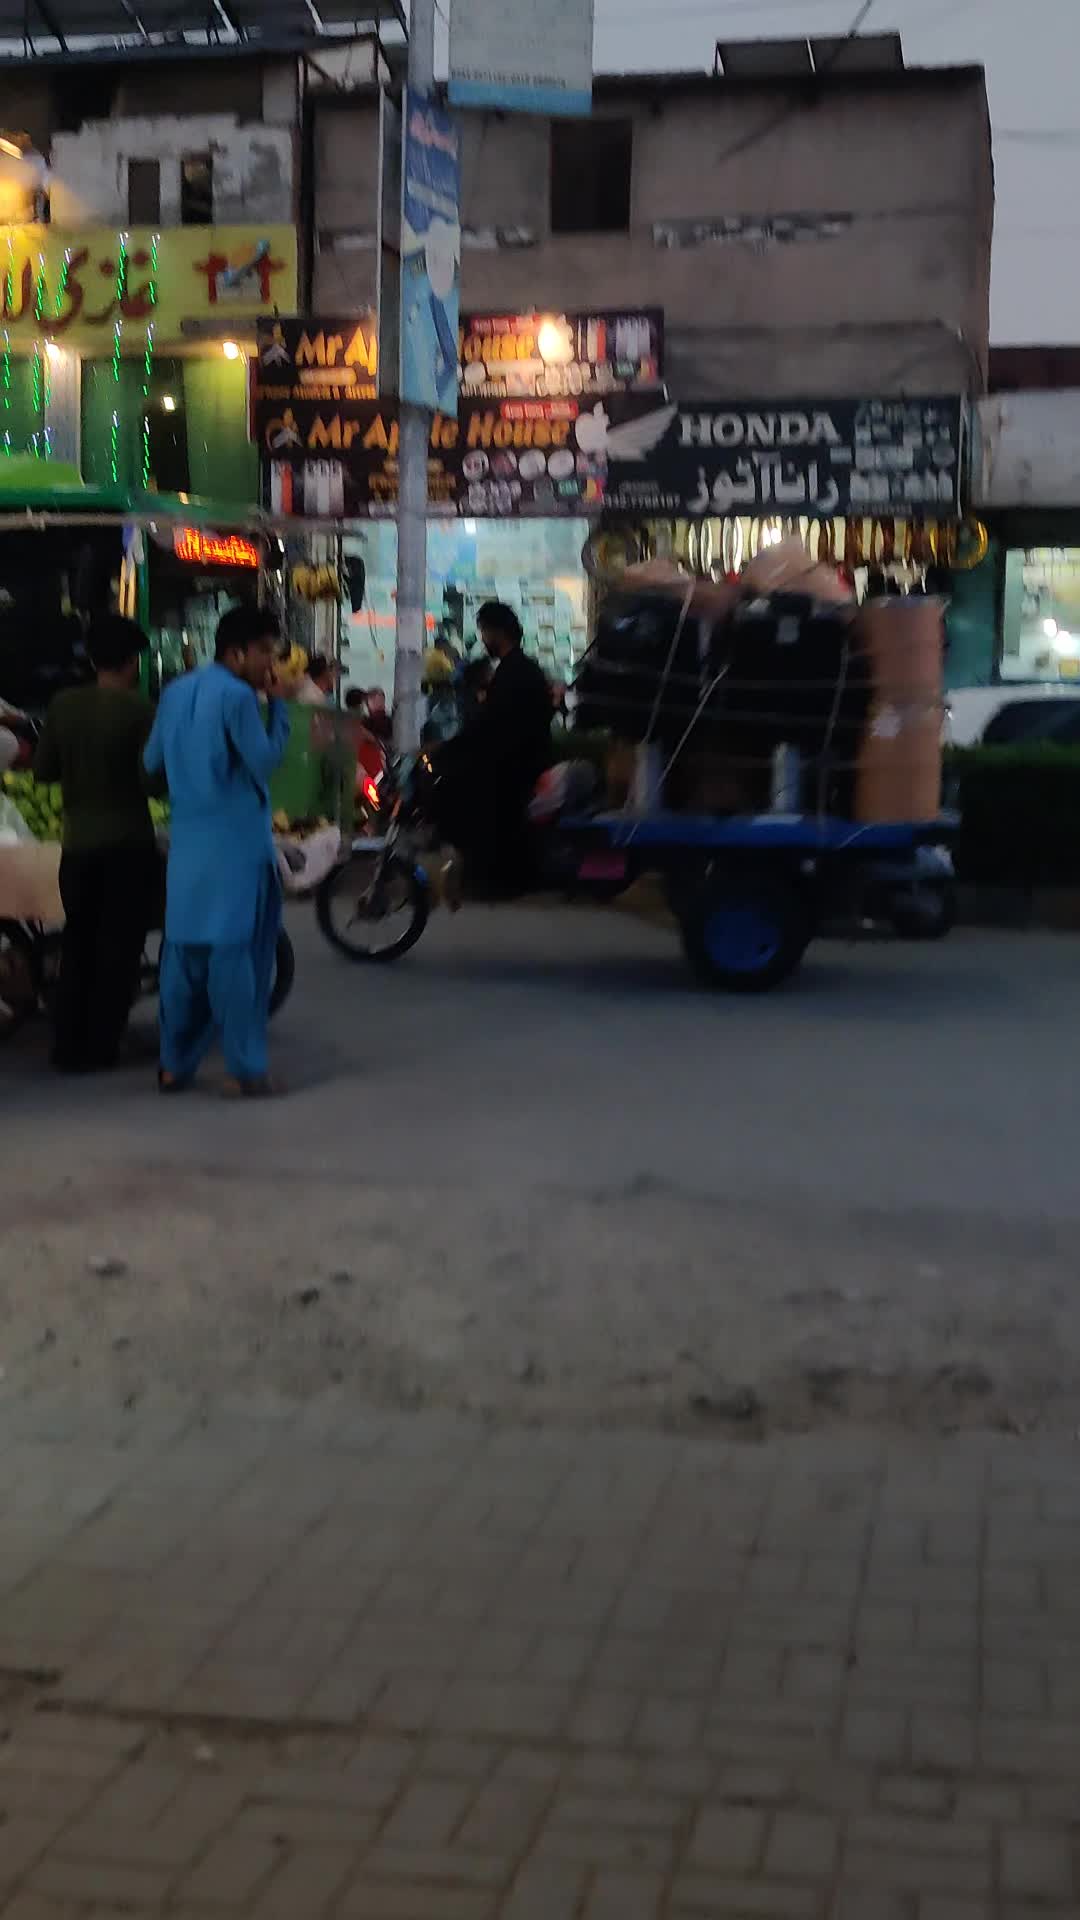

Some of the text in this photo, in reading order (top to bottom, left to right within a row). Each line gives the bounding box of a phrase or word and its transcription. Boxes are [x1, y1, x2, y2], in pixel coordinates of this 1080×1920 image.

[295, 329, 343, 366] Mr
[308, 412, 360, 449] Mr
[363, 412, 459, 456] Aple
[678, 411, 841, 447] HONDA
